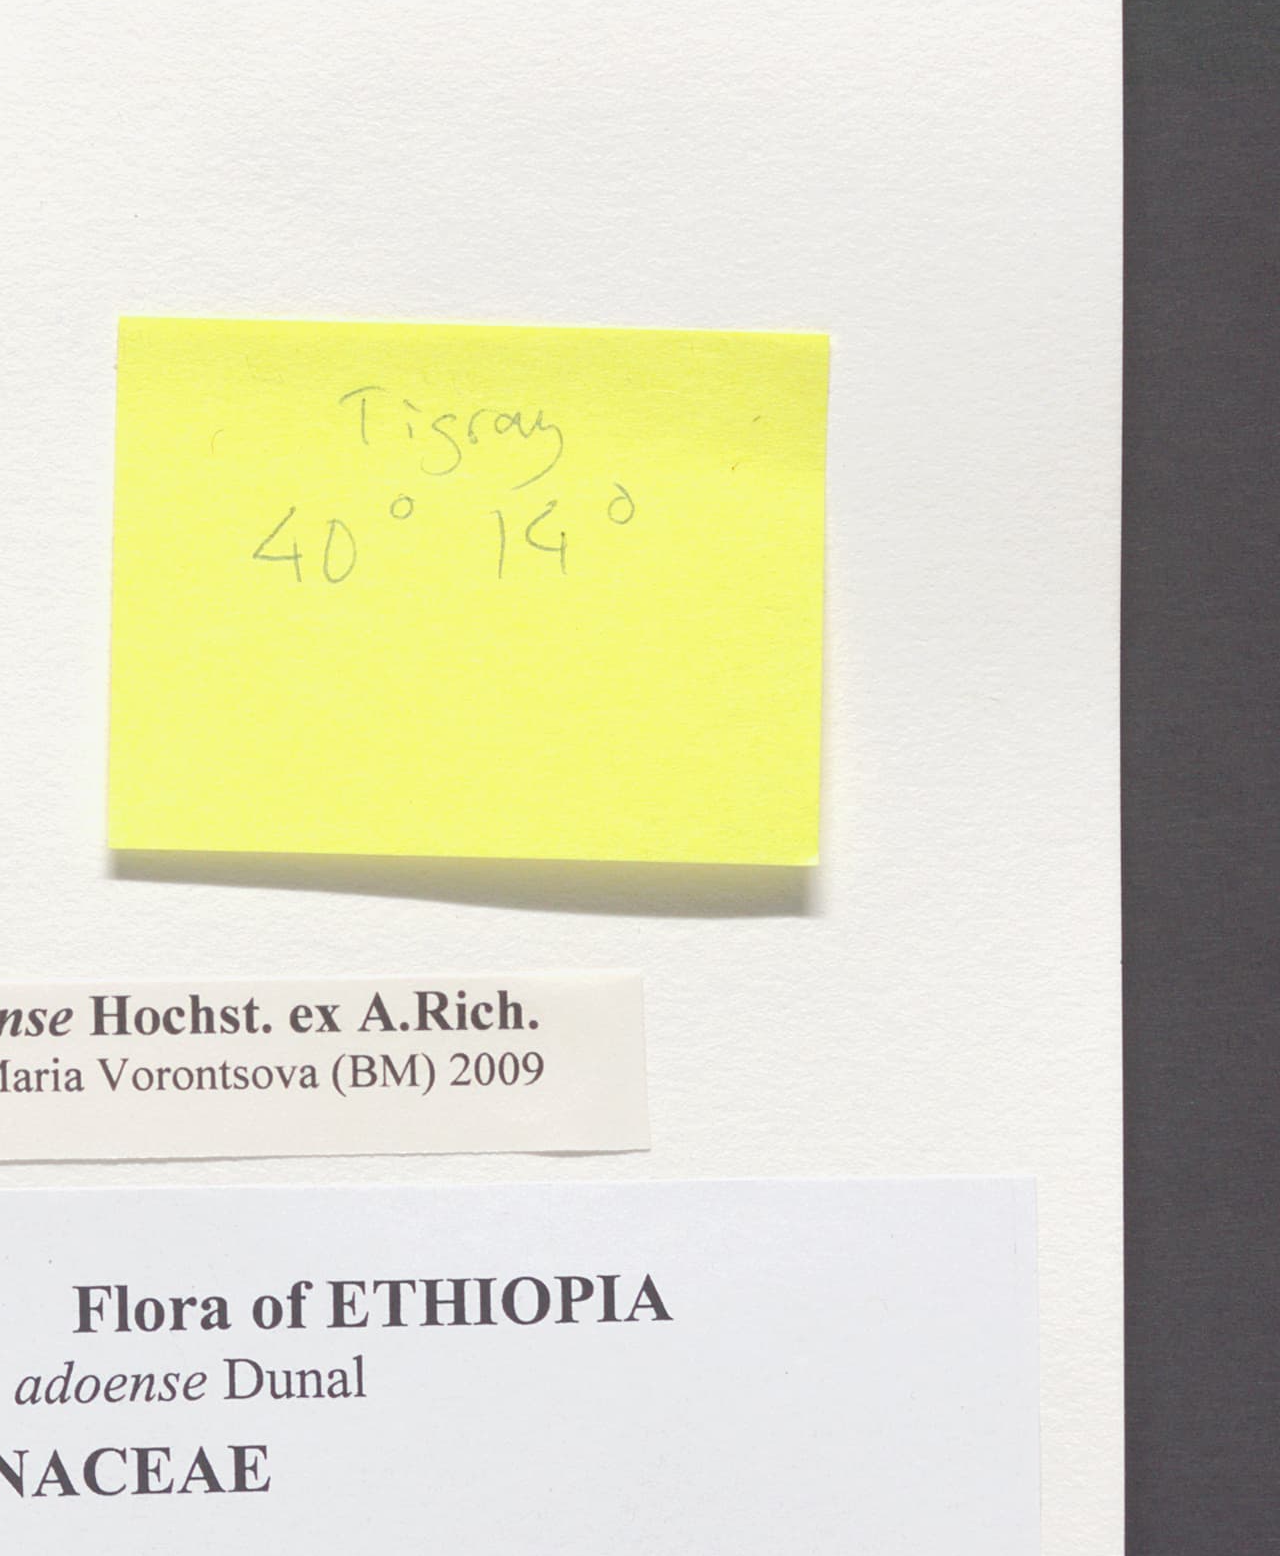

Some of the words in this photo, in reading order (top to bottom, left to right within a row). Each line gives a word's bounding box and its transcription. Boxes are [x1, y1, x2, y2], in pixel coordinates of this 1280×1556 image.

[340, 386, 564, 490] Tigray
[88, 993, 273, 1036] Hochst.
[289, 1004, 342, 1034] ex
[357, 989, 539, 1033] A.Rich.
[96, 1057, 320, 1092] Vorontsova
[331, 1052, 436, 1098] (BM)
[449, 1051, 545, 1087] 2009
[71, 1284, 233, 1334] Flora
[252, 1279, 314, 1331] of
[326, 1273, 674, 1329] ETHIOPIA
[14, 1360, 208, 1406] adoense
[222, 1354, 367, 1400] Dunal
